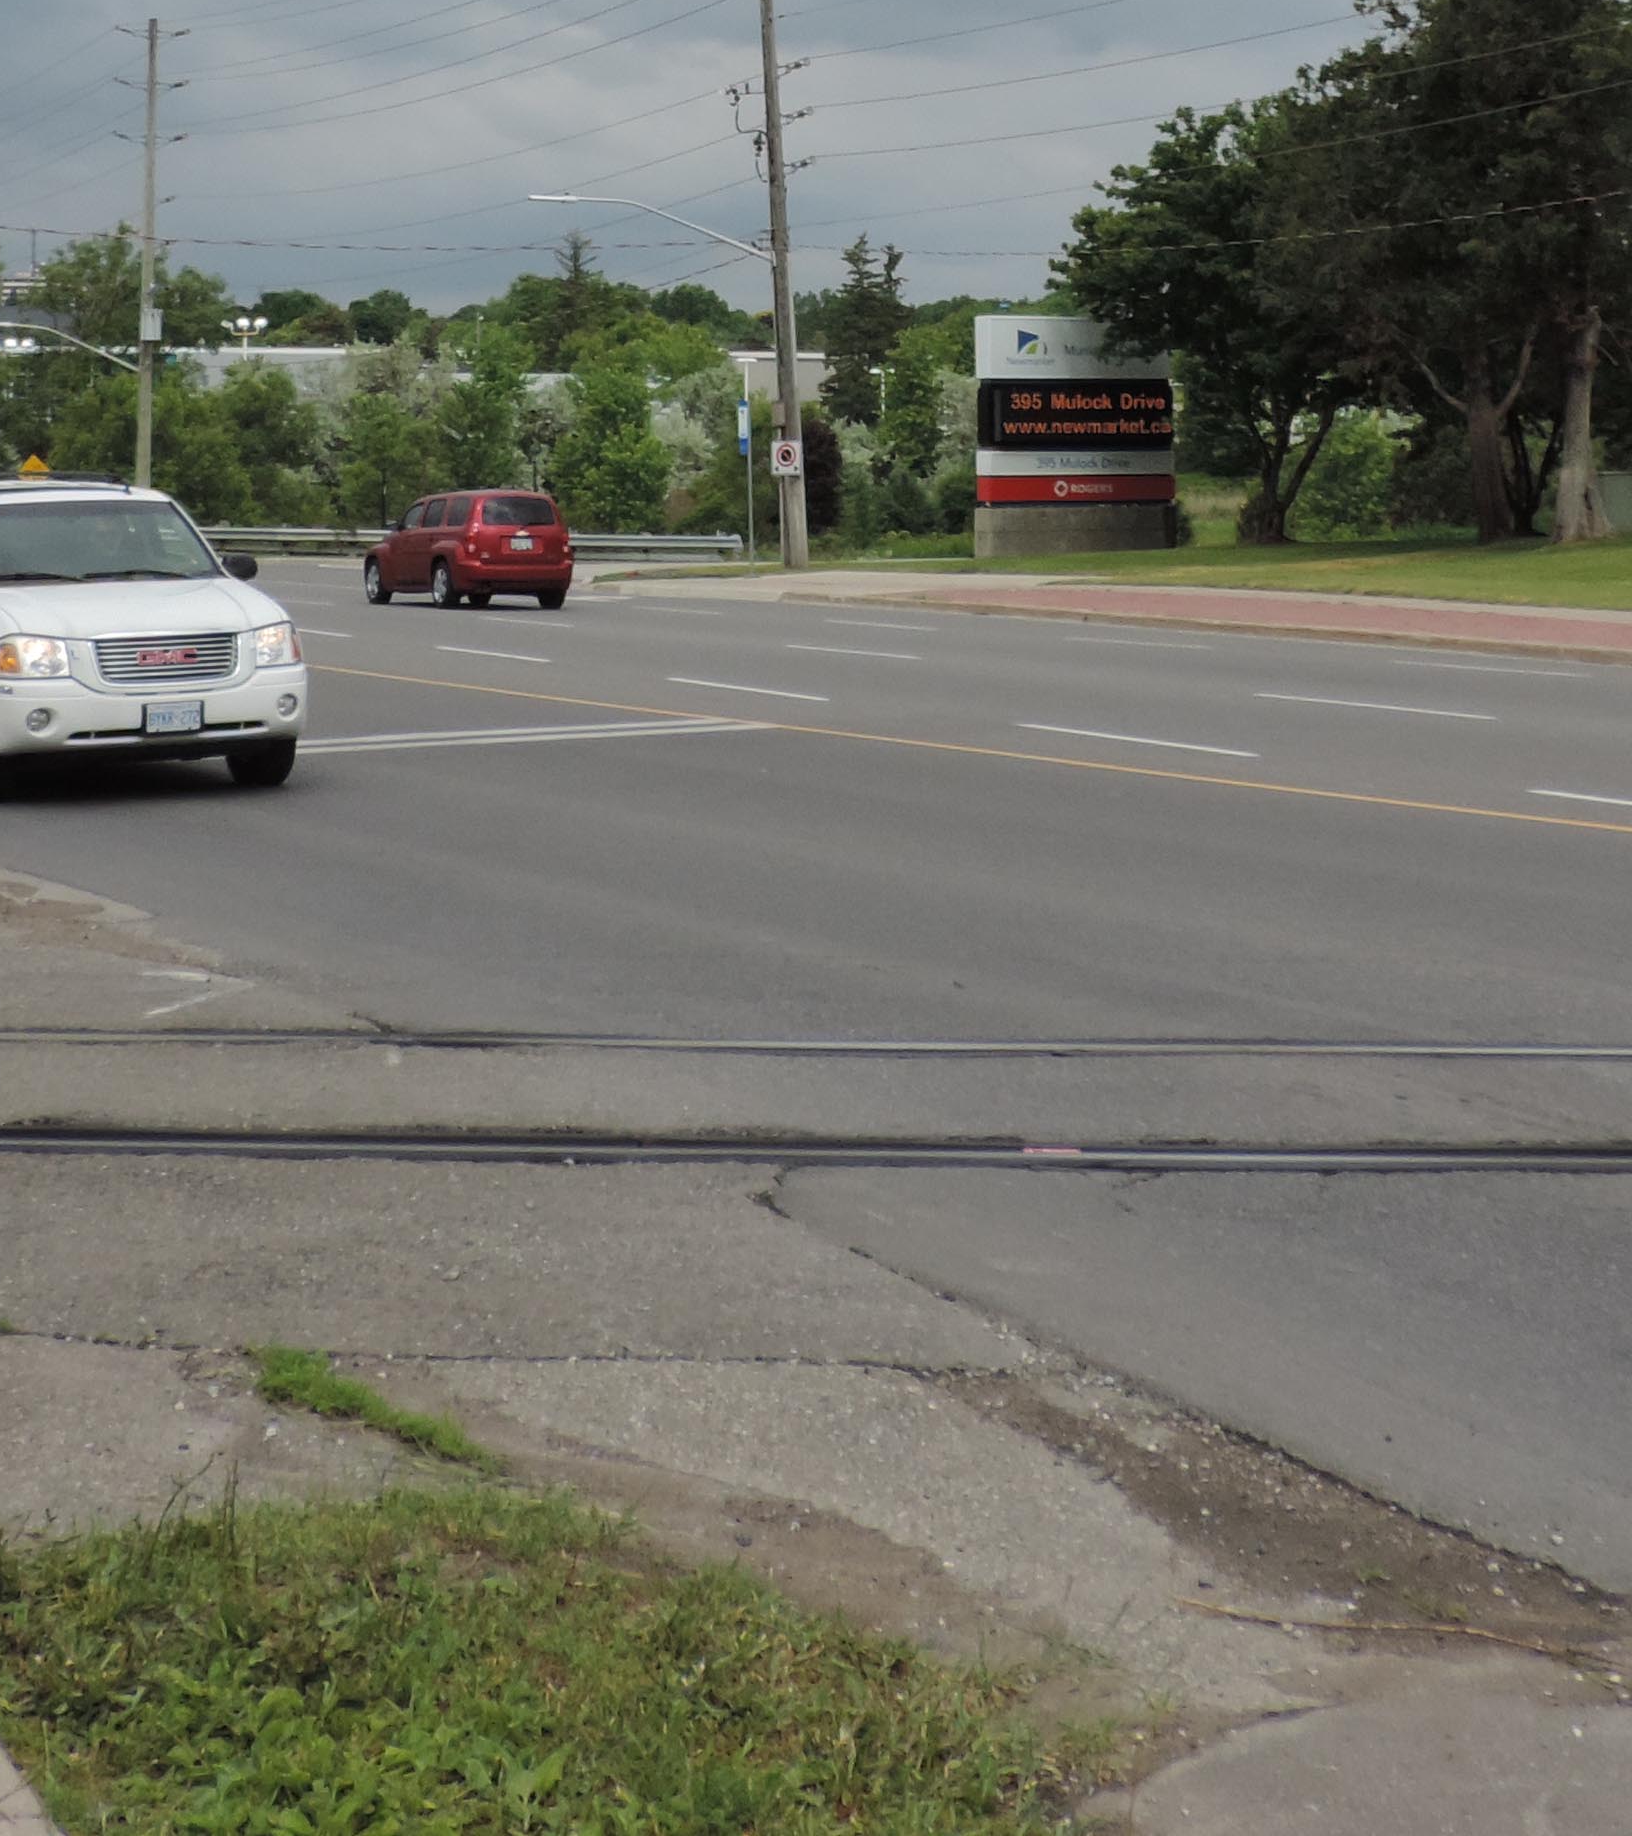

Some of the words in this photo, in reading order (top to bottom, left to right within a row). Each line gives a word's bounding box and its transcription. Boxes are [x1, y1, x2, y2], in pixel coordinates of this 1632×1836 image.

[1010, 393, 1042, 410] 395
[1050, 393, 1113, 410] Mulock
[1119, 393, 1166, 410] Drive
[1003, 418, 1172, 435] www.newmarket.ca
[1070, 483, 1114, 494] ROGERS
[135, 647, 200, 667] GMC
